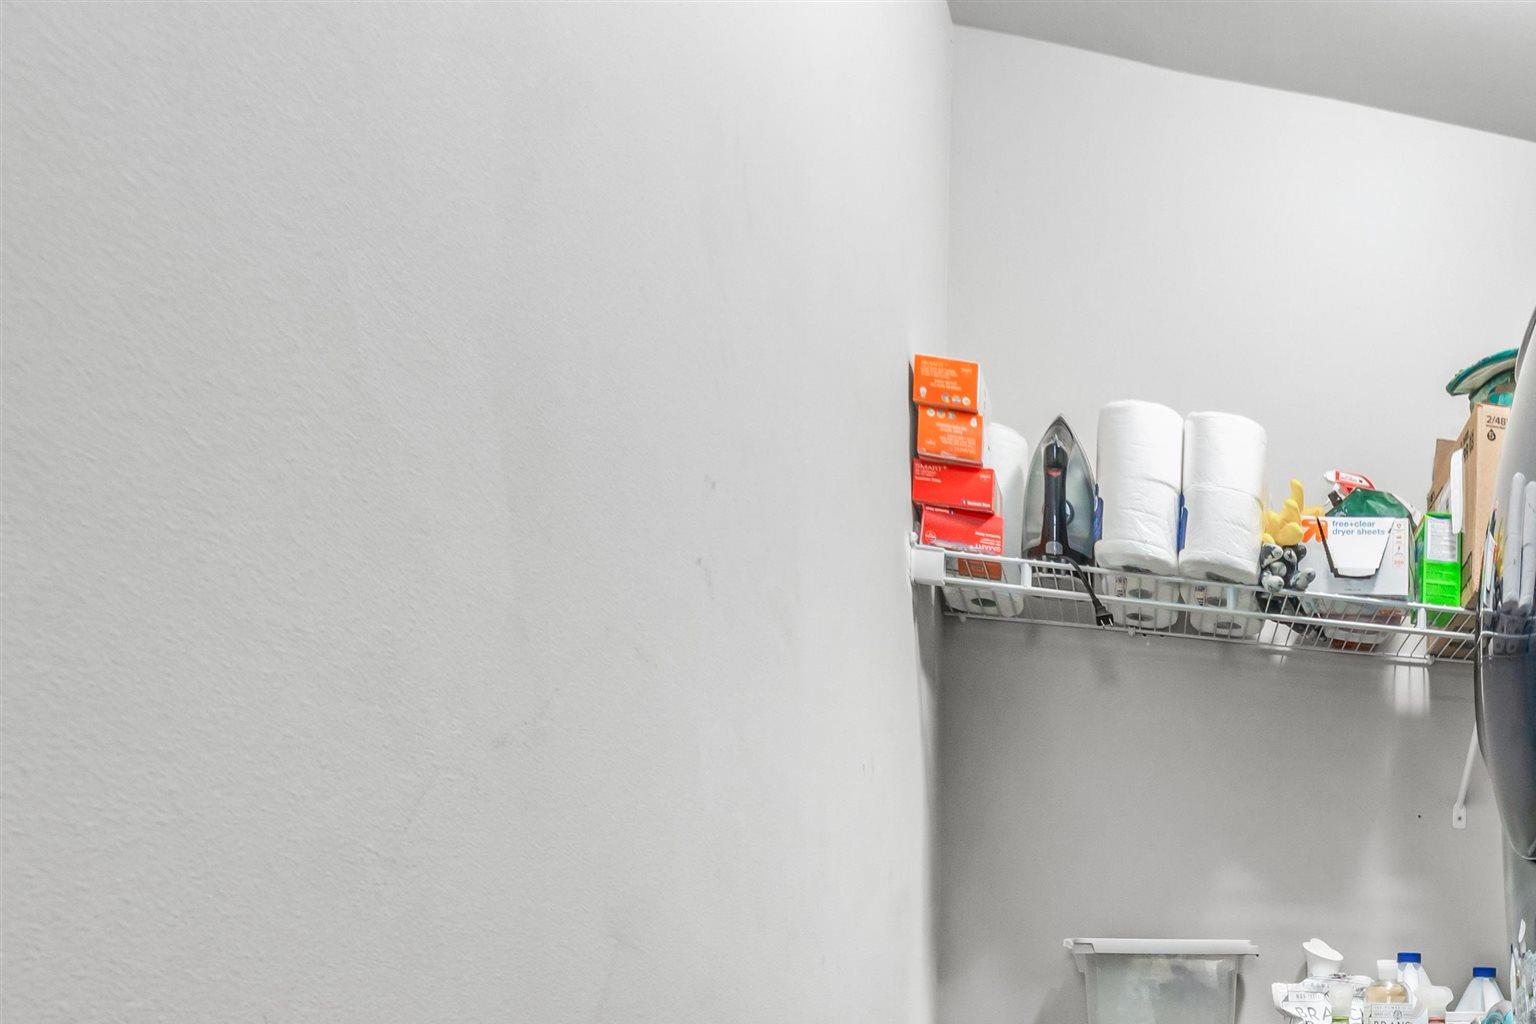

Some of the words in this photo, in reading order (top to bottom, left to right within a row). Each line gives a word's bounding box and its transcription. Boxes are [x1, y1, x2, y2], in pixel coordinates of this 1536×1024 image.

[1332, 520, 1376, 528] free+clear
[1332, 528, 1355, 536] dryer
[1356, 528, 1386, 536] sheets
